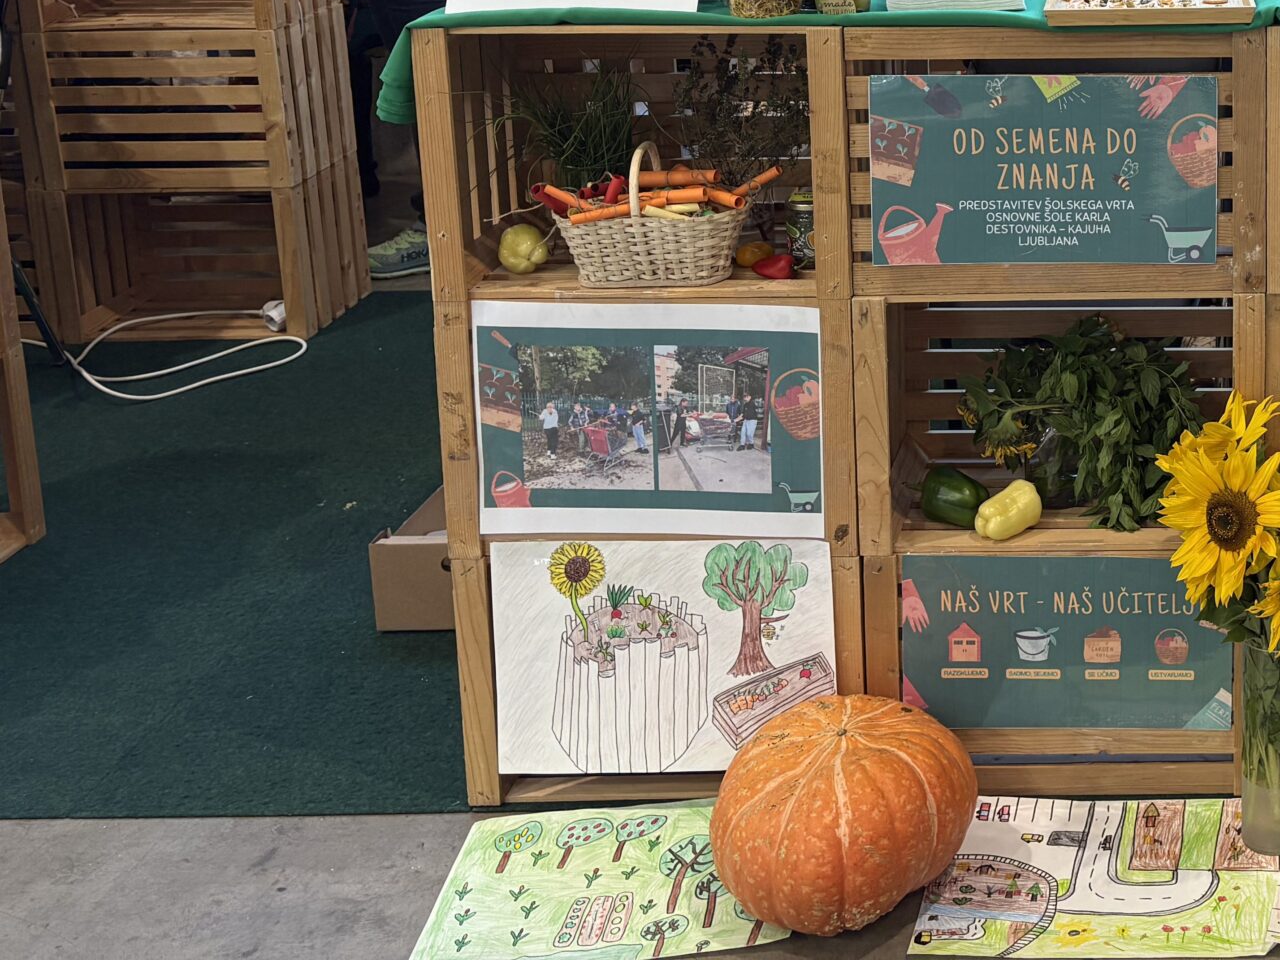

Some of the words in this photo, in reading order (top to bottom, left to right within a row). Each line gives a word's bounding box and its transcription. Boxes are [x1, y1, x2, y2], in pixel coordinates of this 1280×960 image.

[952, 127, 985, 156] OD
[995, 126, 1097, 156] SEMENA
[1106, 127, 1137, 155] DO
[996, 163, 1096, 191] ZNANJA
[959, 200, 1042, 210] PREDSTAVITEV
[1044, 197, 1104, 210] ŠOLSKEGA
[1106, 200, 1135, 210] VRTA
[986, 212, 1042, 222] OSNOVNE
[1044, 209, 1073, 222] ŠOLE
[1075, 212, 1111, 222] KARLA
[986, 224, 1057, 234] DESTOVNIKA
[1068, 224, 1111, 234] KAJUHA
[1018, 236, 1079, 246] LJUBLJANA
[940, 585, 980, 613] NAŠ
[988, 590, 1029, 614] VRT
[1053, 586, 1093, 615] NAŠ
[1102, 587, 1195, 615] UČITELJ
